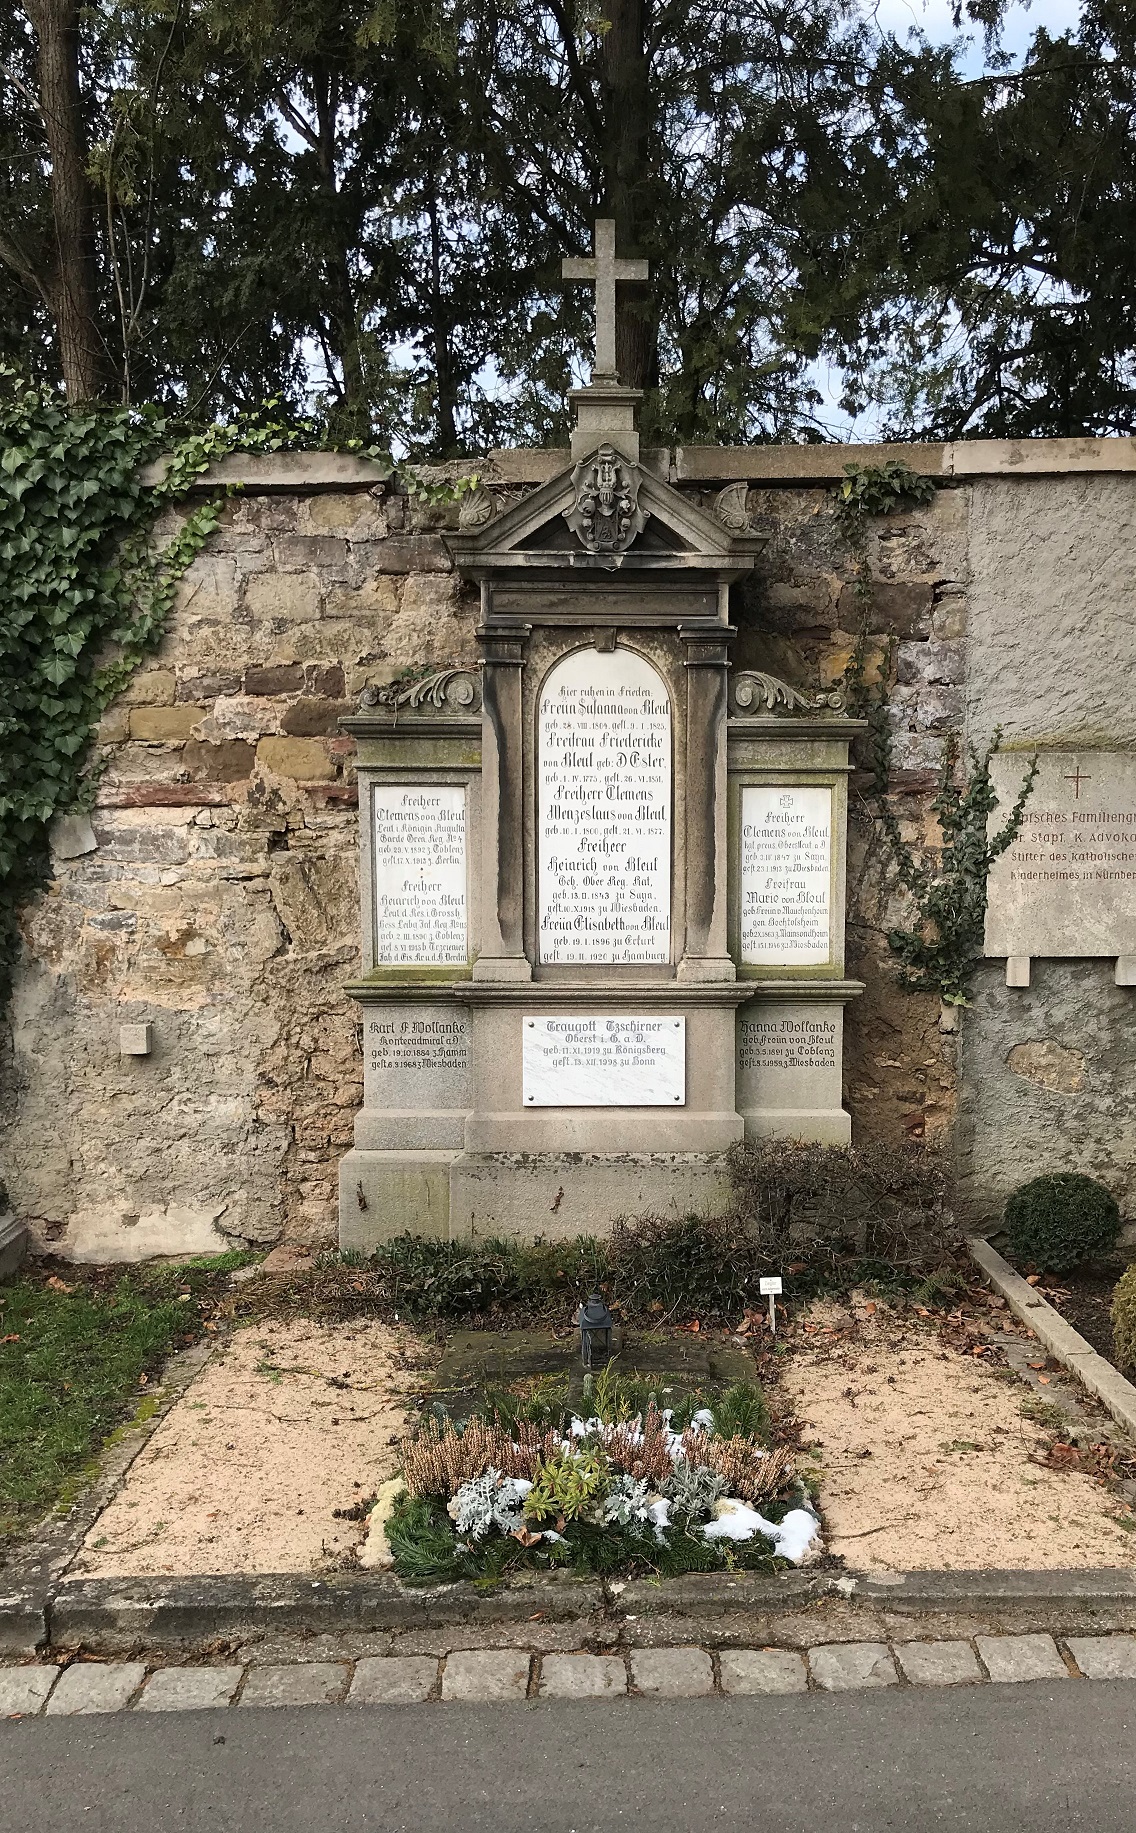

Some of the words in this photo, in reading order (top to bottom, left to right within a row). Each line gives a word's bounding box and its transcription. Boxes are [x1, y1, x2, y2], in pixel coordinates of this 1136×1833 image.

[558, 686, 577, 700] Hier
[580, 686, 605, 700] ruhen
[607, 687, 615, 696] in
[554, 785, 603, 805] Freiherr
[606, 784, 653, 800] Clemens
[401, 795, 441, 809] Freiherr
[377, 808, 420, 820] Clemens
[765, 812, 805, 826] Freiherr
[744, 825, 785, 838] Clemens
[577, 837, 626, 857] Freiherr
[1012, 852, 1045, 861] Stifter
[1050, 852, 1067, 861] des
[548, 856, 598, 876] Heinrich
[1083, 871, 1093, 880] in
[401, 880, 442, 894] Freiherr
[765, 878, 806, 892] Freifrau
[380, 895, 420, 908] Heinrich
[616, 892, 625, 902] zu
[746, 892, 779, 903] Marie
[598, 906, 608, 916] zu
[574, 915, 625, 931] Elisabeth
[613, 939, 622, 947] zu
[625, 935, 655, 946] Erfurt
[611, 953, 619, 962] zu
[369, 1022, 395, 1033] Karl
[412, 1022, 465, 1033] Wollanke
[547, 1020, 597, 1033] Traugott
[606, 1020, 663, 1034] Tzschirner
[739, 1020, 777, 1036] Hanna
[780, 1020, 836, 1033] Wollanke
[380, 1036, 444, 1045] Konteradmiral
[565, 1034, 597, 1043] Oberst
[759, 1035, 787, 1046] Freiin
[602, 1047, 612, 1056] zu
[615, 1045, 666, 1056] Königsberg
[785, 1048, 795, 1057] zu
[798, 1046, 835, 1057] Coblenz
[620, 1058, 630, 1067] zu
[632, 1056, 655, 1066] Bonn
